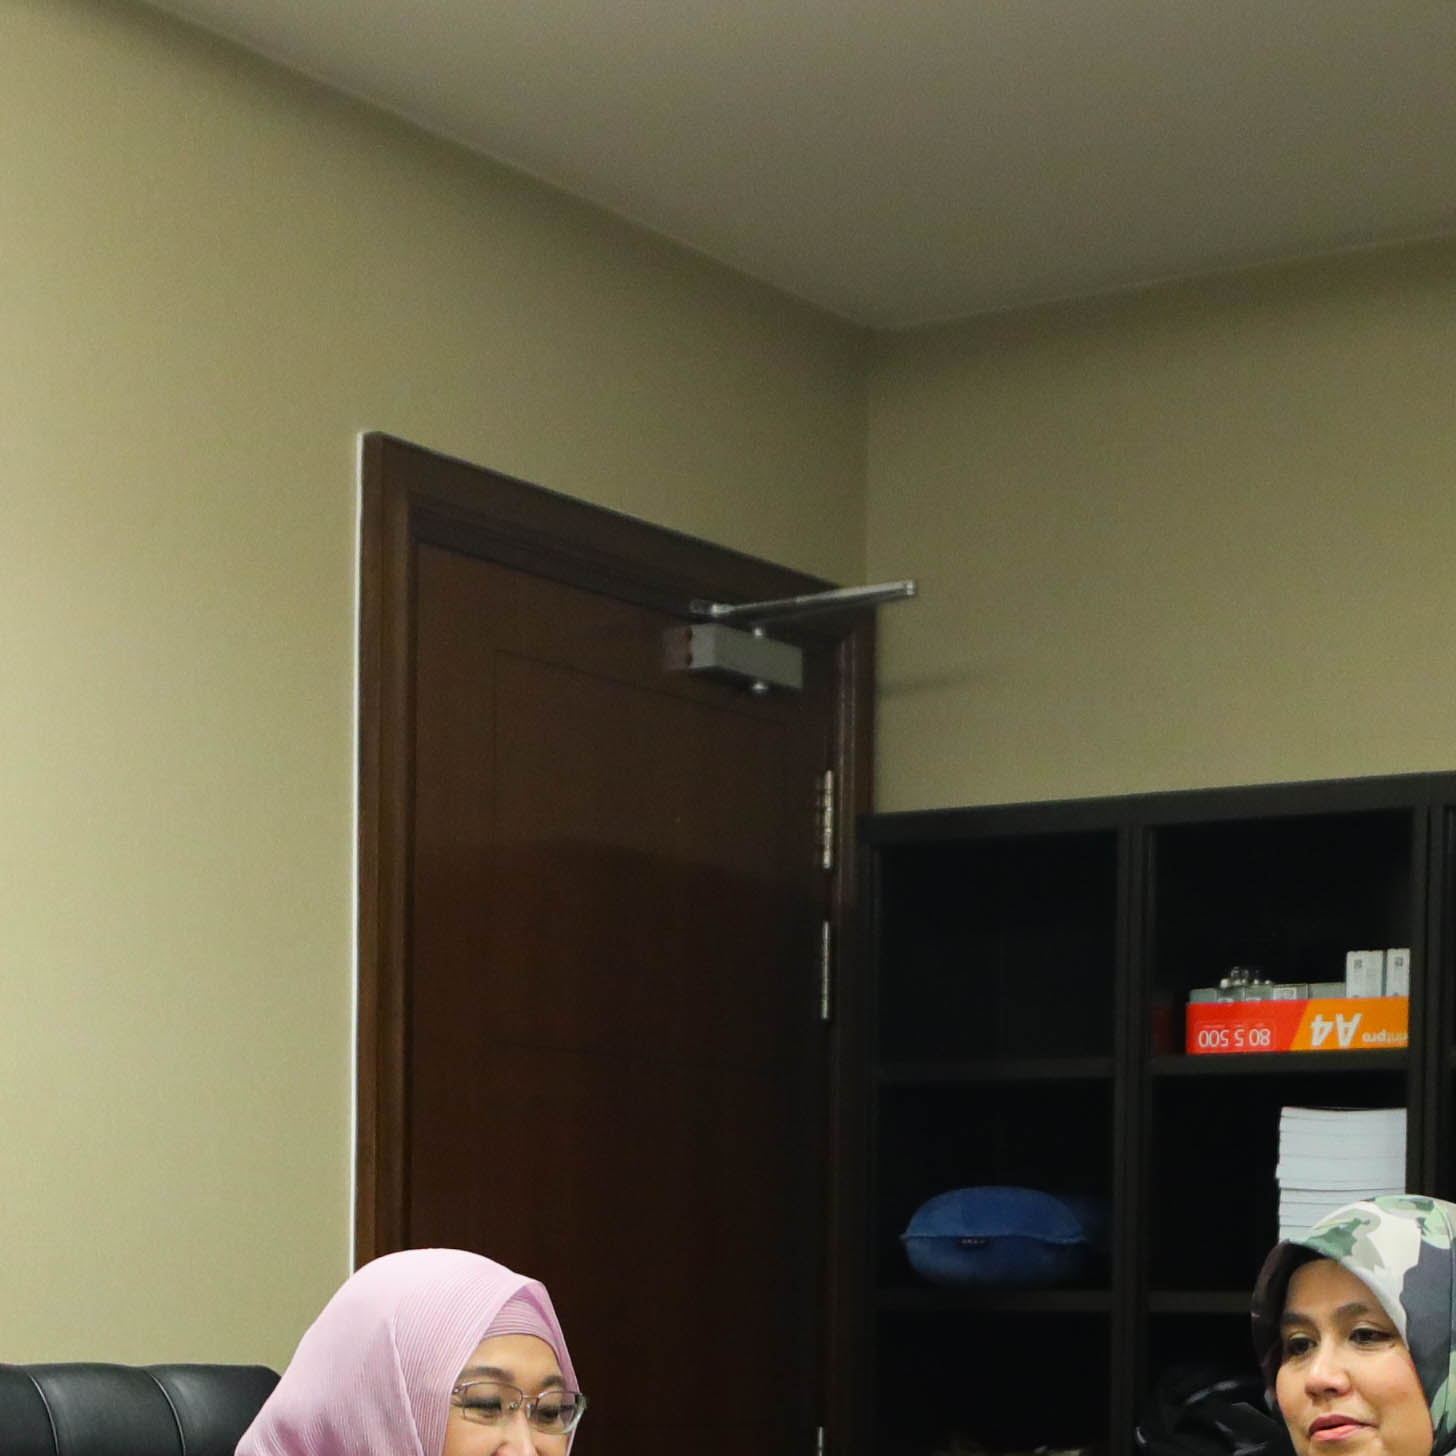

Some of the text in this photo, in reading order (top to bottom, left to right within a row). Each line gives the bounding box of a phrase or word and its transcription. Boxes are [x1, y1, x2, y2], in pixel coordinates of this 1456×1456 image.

[1198, 1028, 1272, 1048] 80 5 500
[1311, 1013, 1363, 1049] A4
